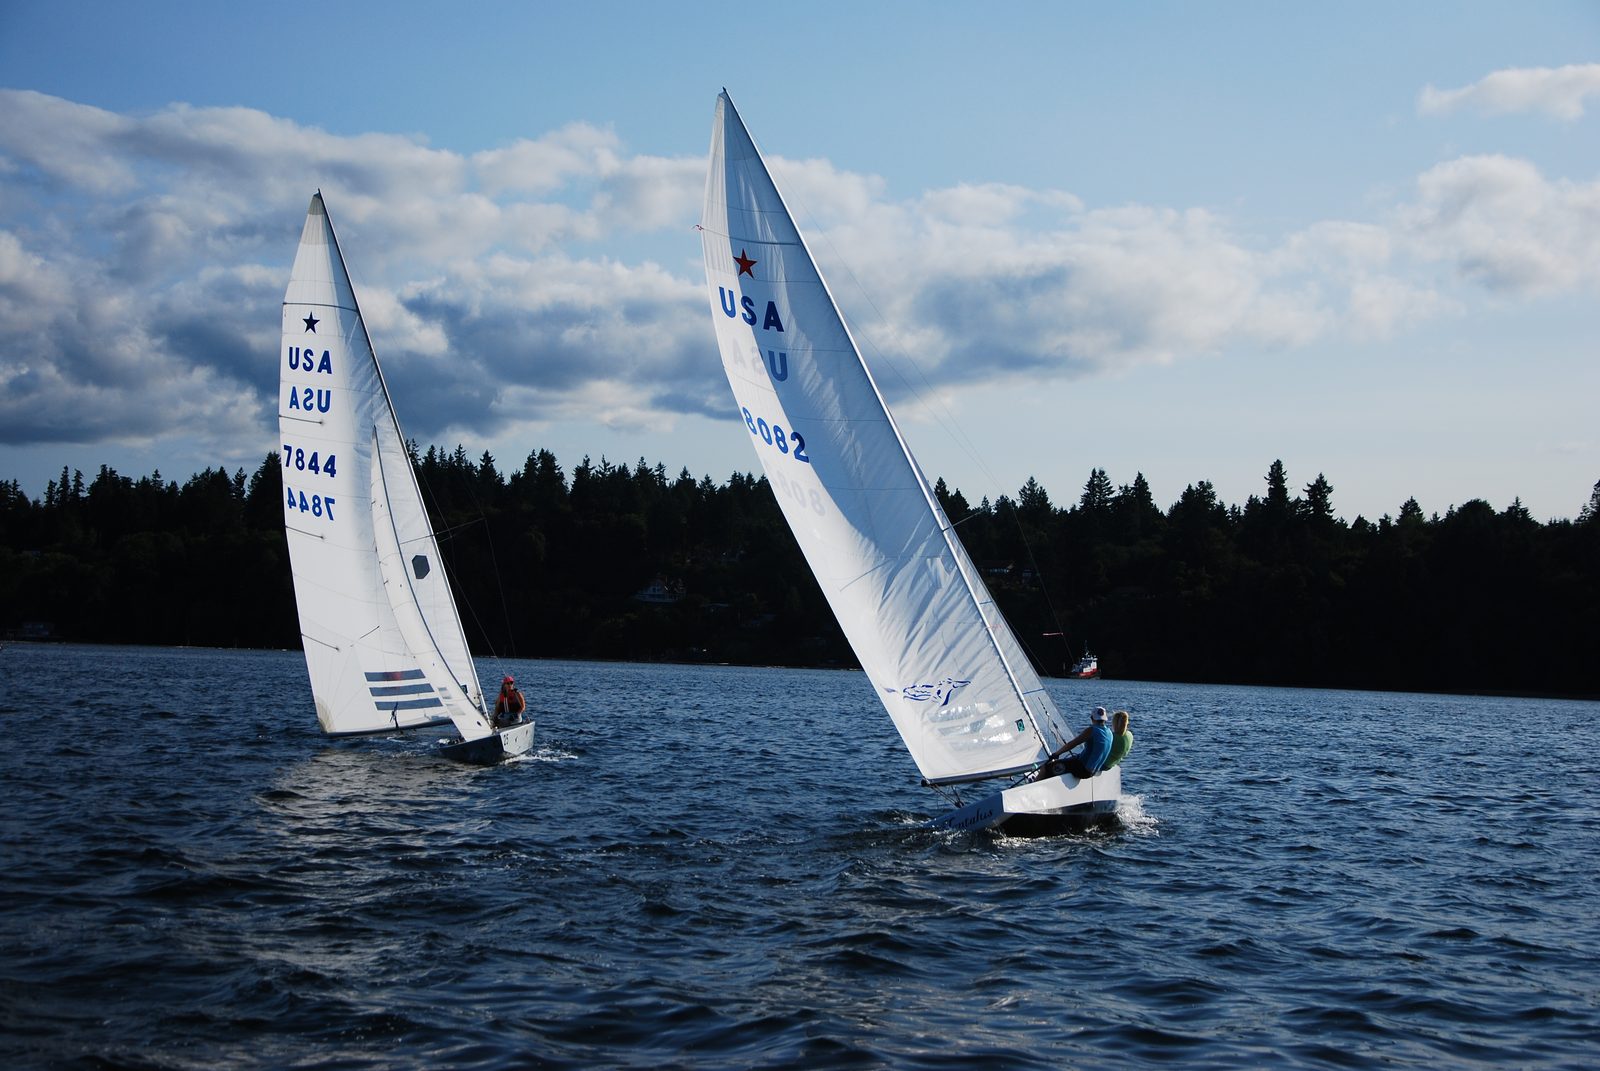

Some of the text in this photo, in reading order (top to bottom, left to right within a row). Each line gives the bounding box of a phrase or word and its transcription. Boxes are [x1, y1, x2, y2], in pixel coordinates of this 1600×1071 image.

[718, 286, 785, 333] USA
[288, 346, 333, 375] USA
[742, 406, 810, 464] 8082
[283, 444, 337, 478] 7844
